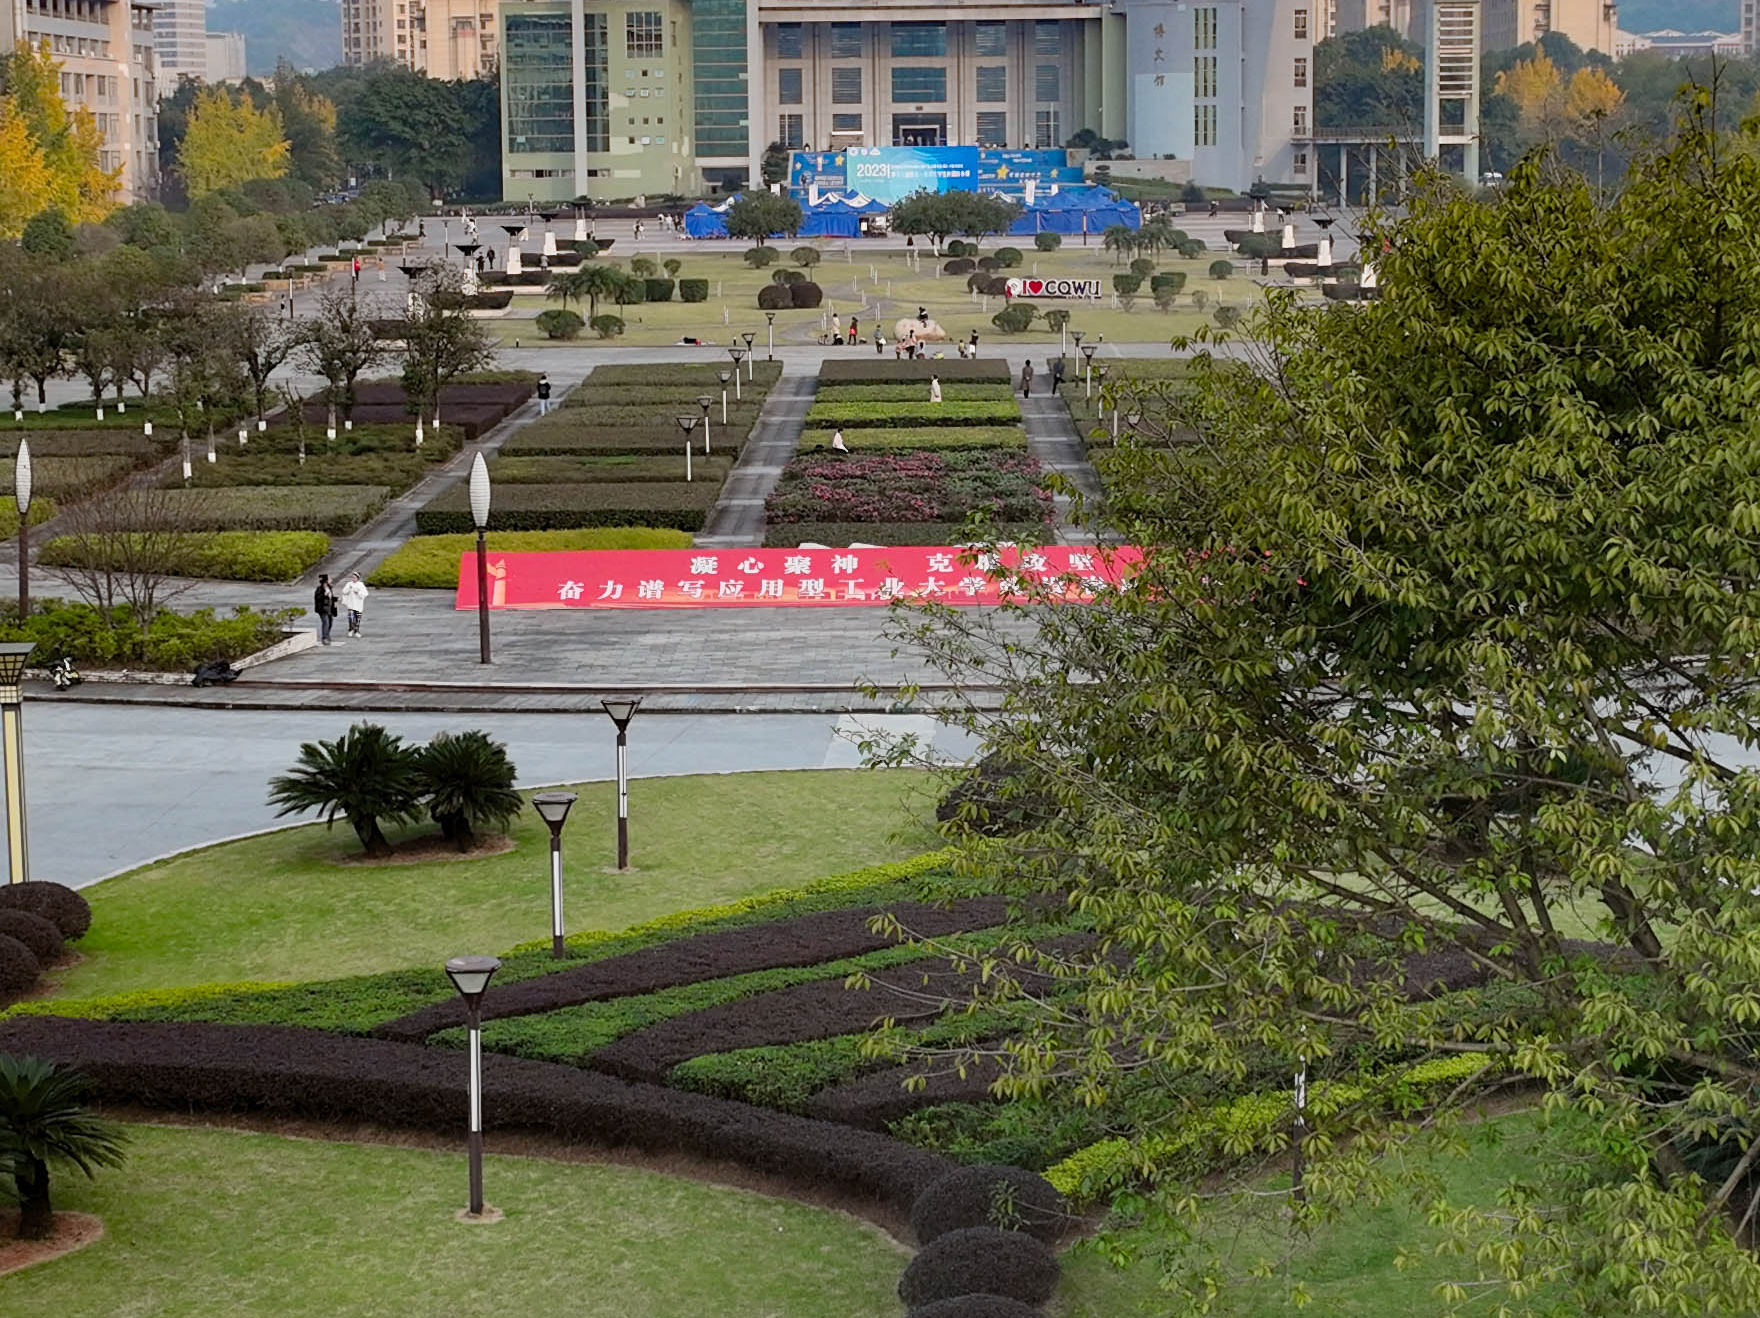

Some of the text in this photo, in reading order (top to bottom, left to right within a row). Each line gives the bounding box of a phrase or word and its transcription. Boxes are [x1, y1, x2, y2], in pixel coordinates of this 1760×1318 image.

[856, 163, 887, 177] 2023
[690, 554, 858, 574] 凝心聚神
